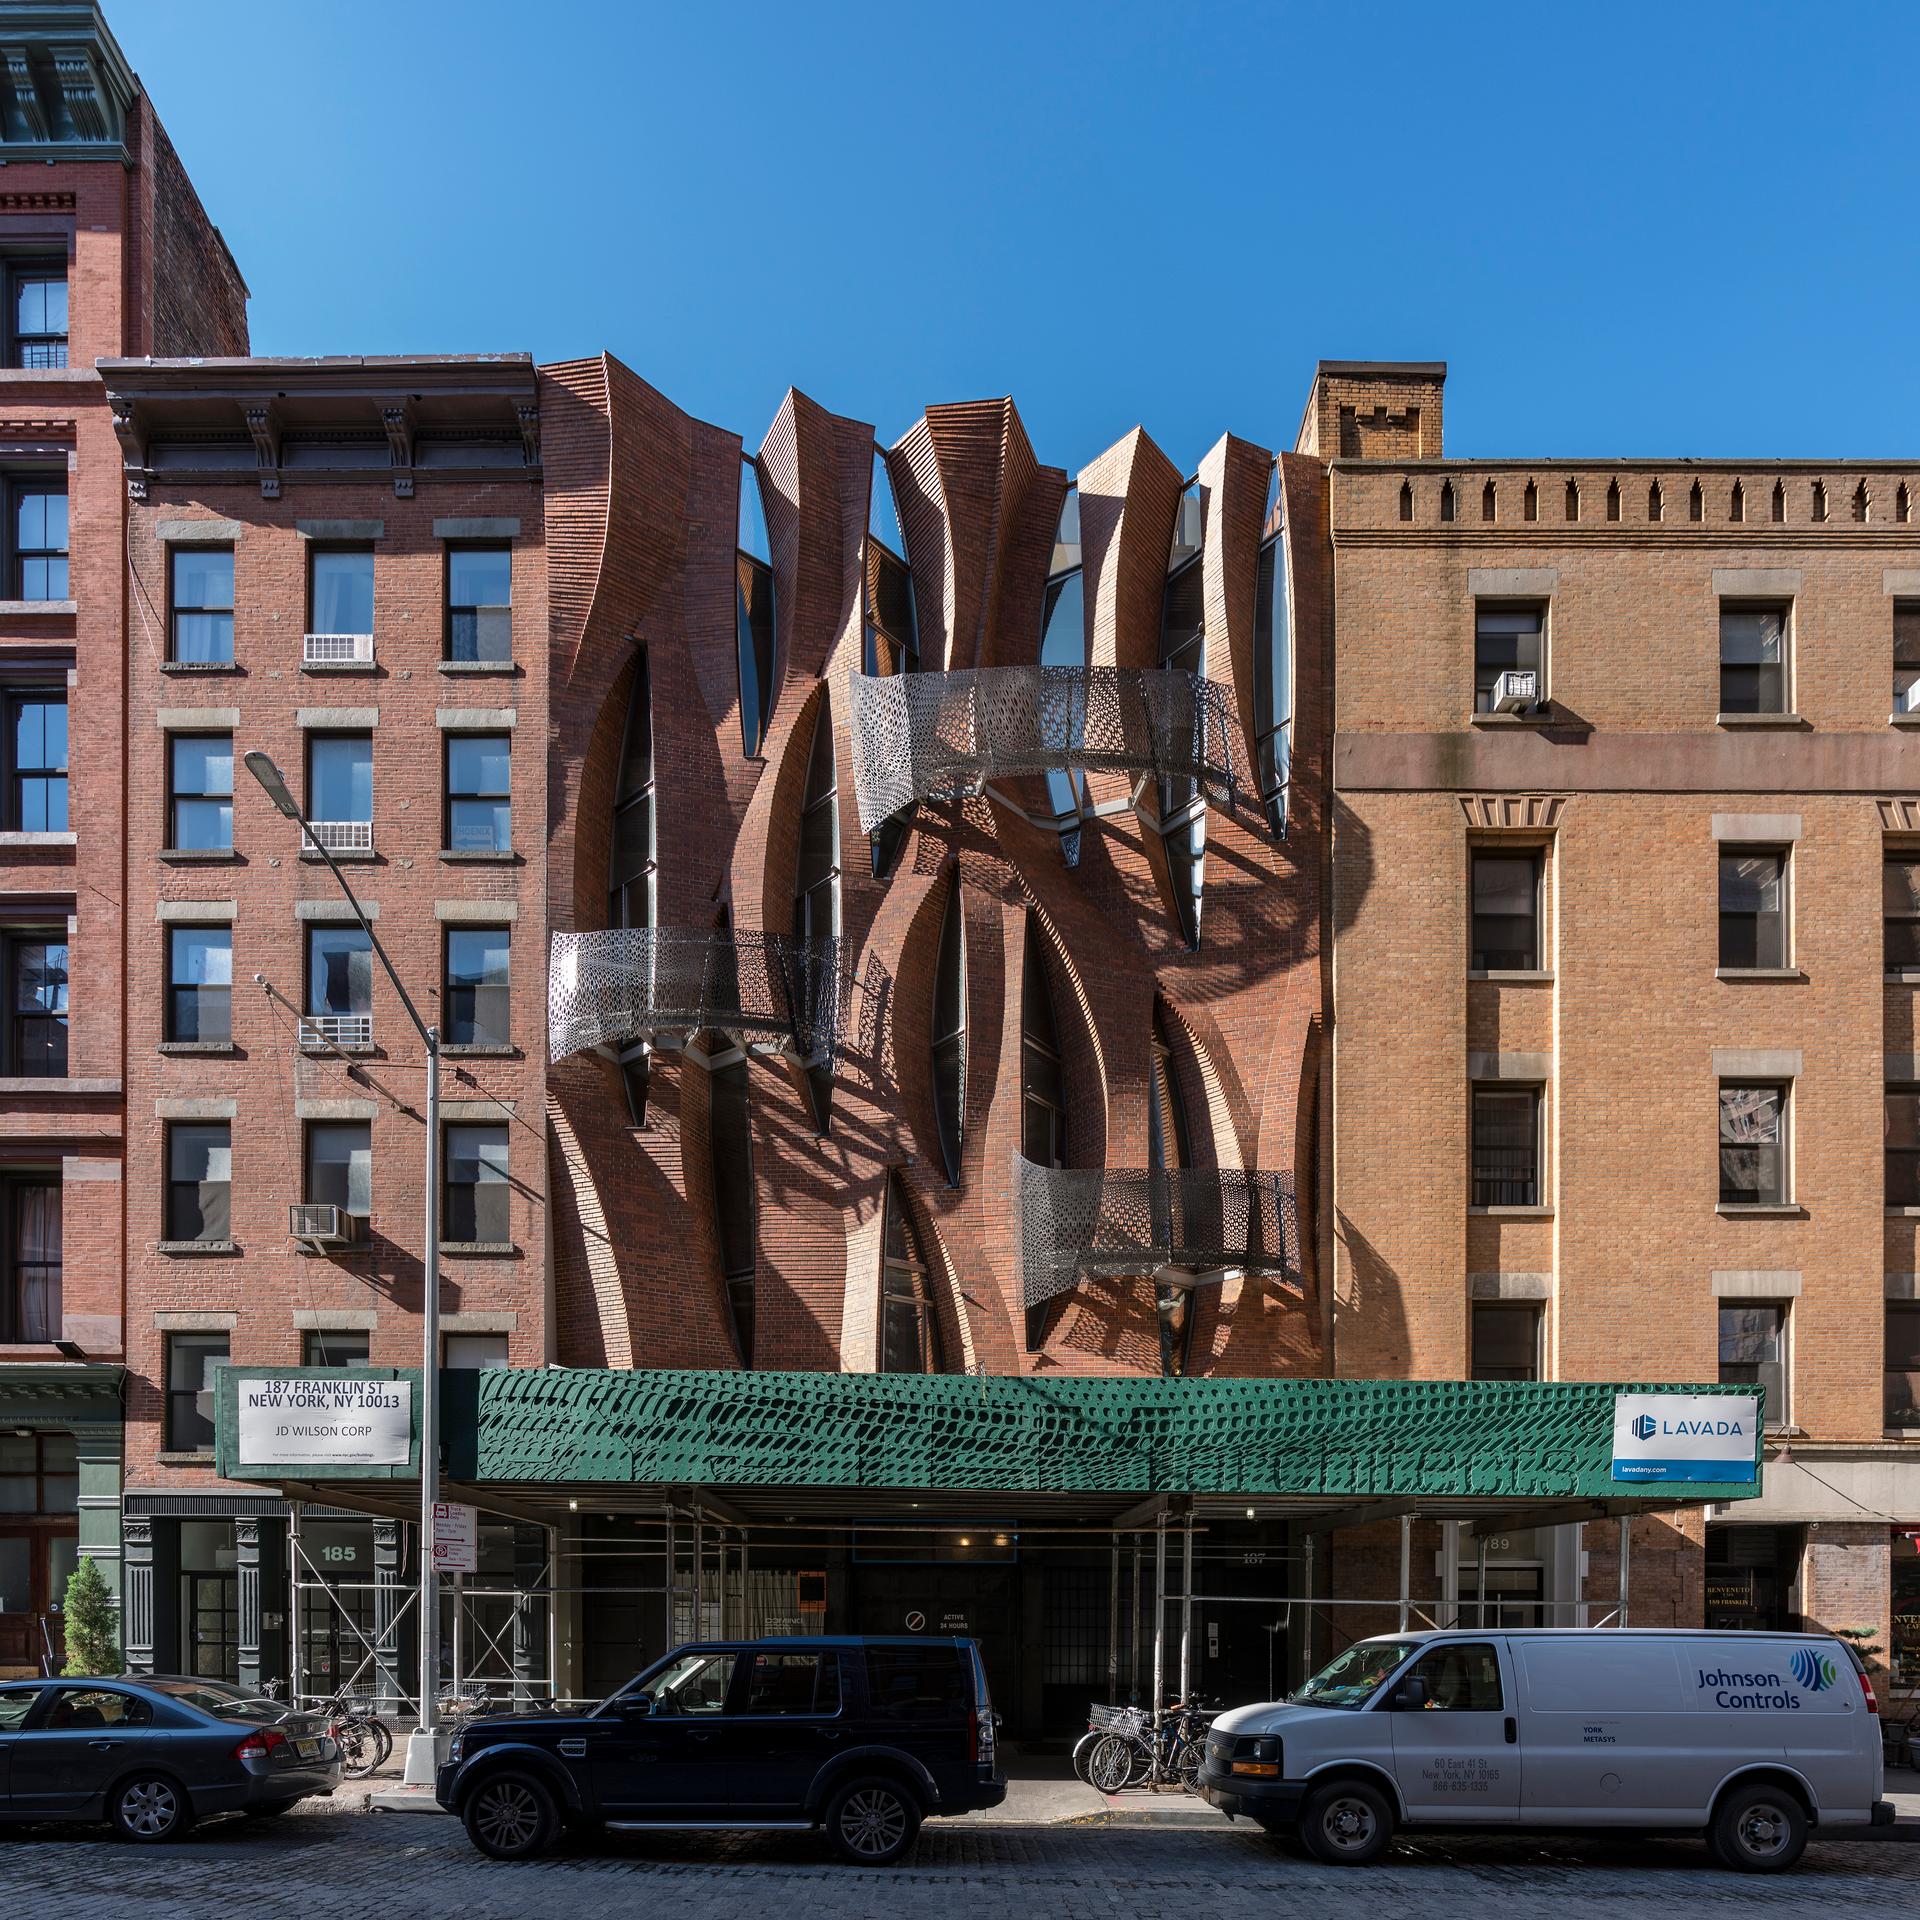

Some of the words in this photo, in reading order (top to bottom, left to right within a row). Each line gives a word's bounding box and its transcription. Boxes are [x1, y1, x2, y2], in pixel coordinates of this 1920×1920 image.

[264, 1380, 290, 1394] 187
[294, 1381, 363, 1394] FRANKLIN
[367, 1382, 385, 1395] ST
[249, 1394, 283, 1407] NEW
[287, 1395, 330, 1410] YORK,
[334, 1395, 353, 1408] NY
[358, 1395, 400, 1408] 10013
[275, 1426, 289, 1437] JD
[291, 1426, 338, 1437] WILSON
[341, 1426, 372, 1437] CORP
[1663, 1420, 1743, 1436] LAVADA
[1621, 1465, 1667, 1474] lavadany.com
[322, 1546, 356, 1561] 185
[1698, 1668, 1781, 1689] Johnson
[1716, 1690, 1801, 1709] Controls
[1434, 1758, 1445, 1769] 60
[1447, 1758, 1465, 1769] East
[1467, 1758, 1476, 1769] 41
[1478, 1758, 1488, 1769] St
[1422, 1769, 1440, 1779] New
[1463, 1769, 1476, 1780] NY
[1478, 1769, 1500, 1780] 10165
[1432, 1780, 1489, 1792] 866-635-1335
